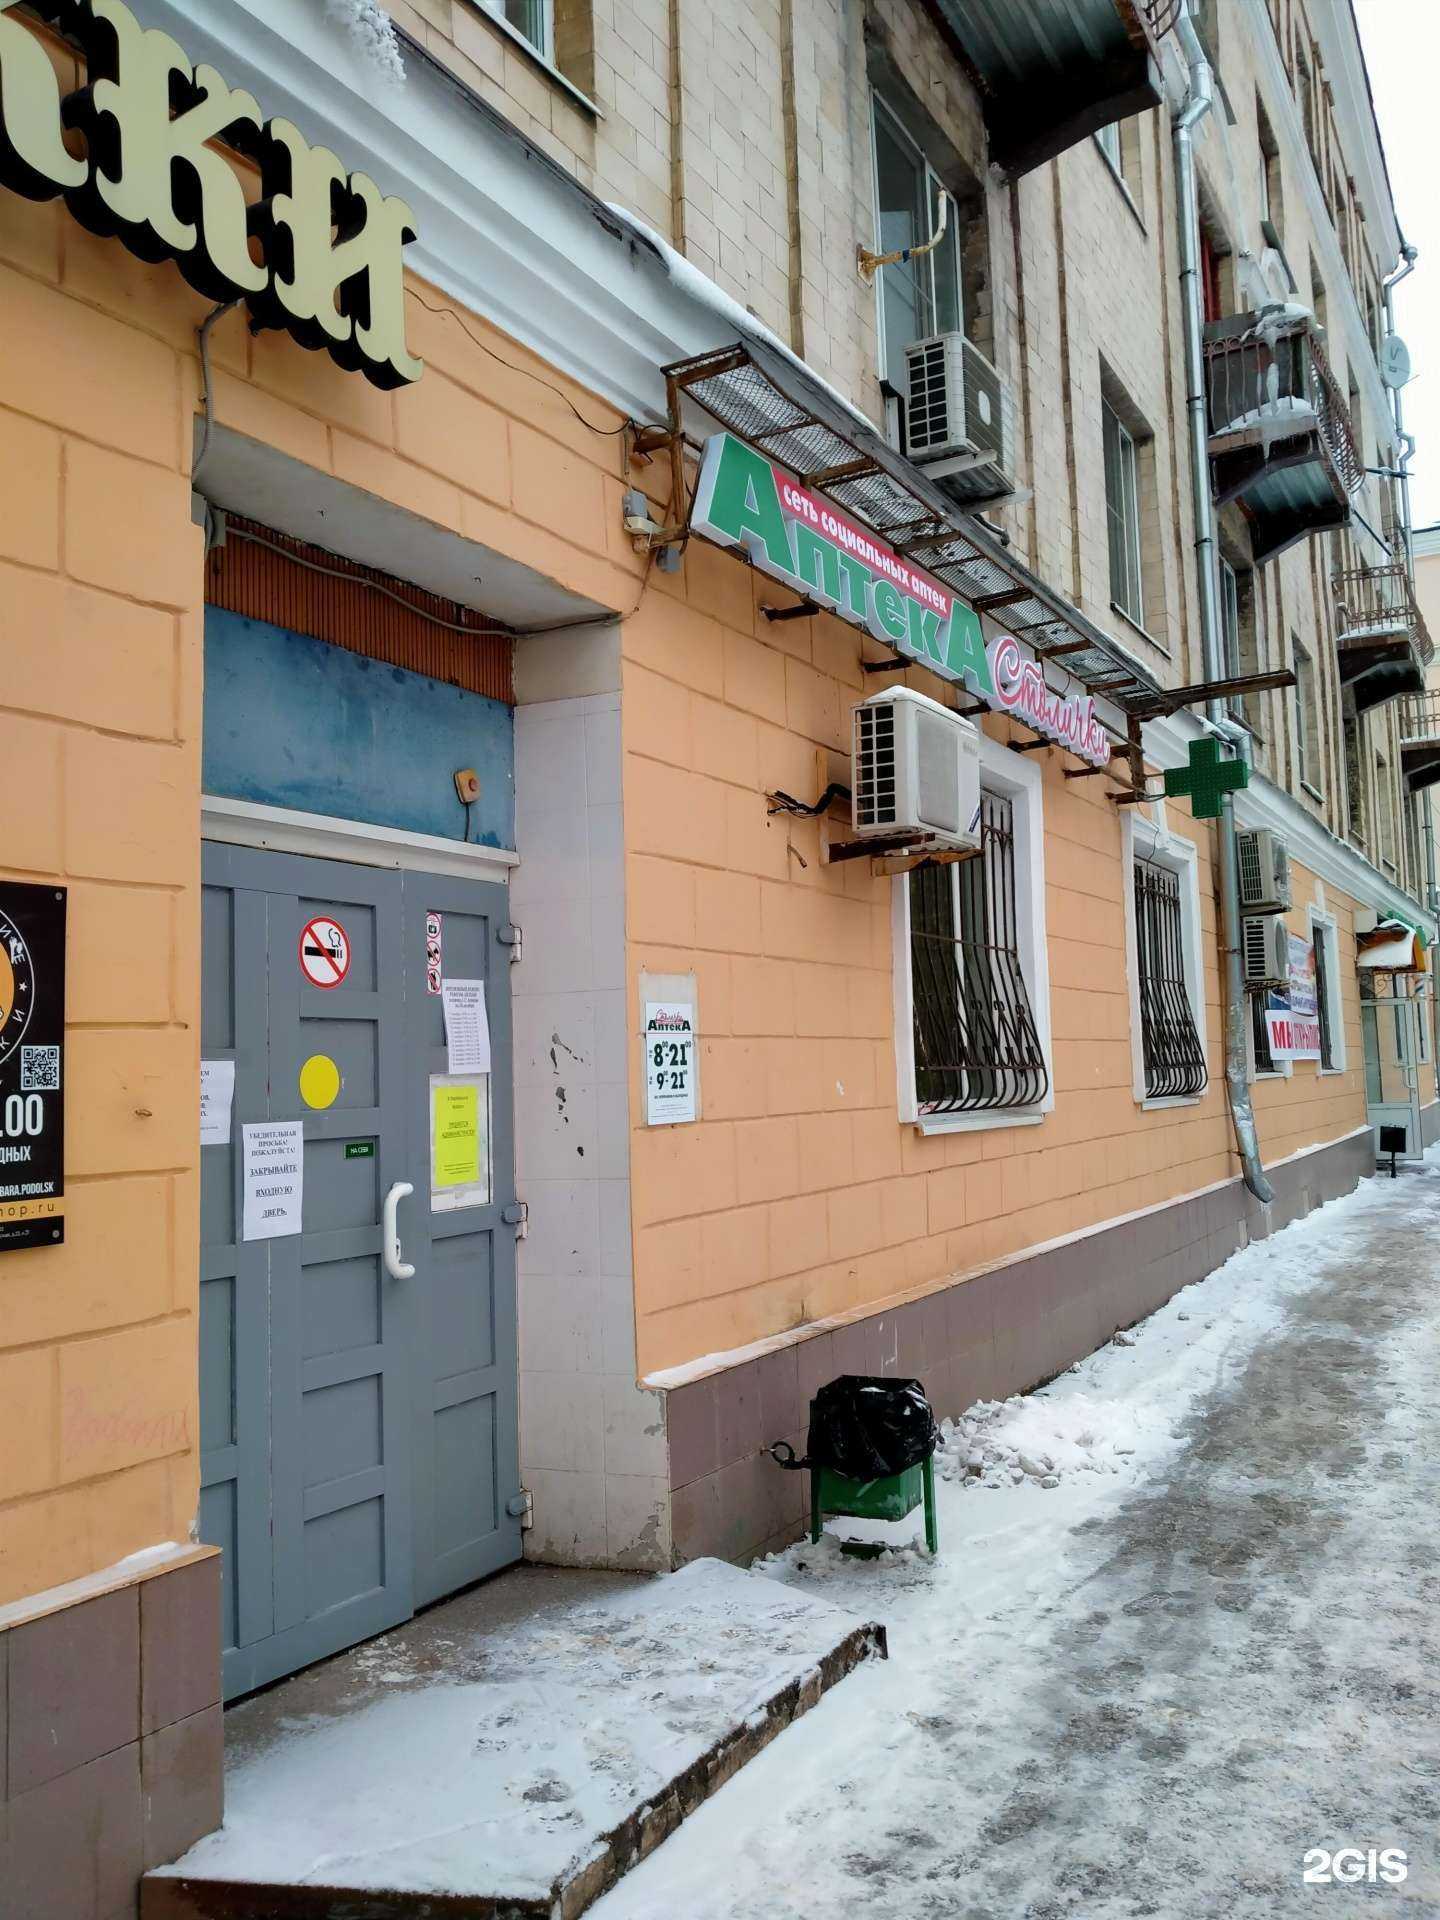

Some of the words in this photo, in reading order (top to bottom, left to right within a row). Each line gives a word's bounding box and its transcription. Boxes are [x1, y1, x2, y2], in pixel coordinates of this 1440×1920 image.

[783, 484, 819, 523] сеть
[821, 510, 910, 588] социальных
[911, 573, 948, 614] аптек
[249, 1130, 297, 1140] УБЕДИТЕЛЬНАЯ
[249, 1163, 298, 1177] ЗАКРЫВАЙТЕ
[255, 1185, 293, 1198] ВХОДНУЮ
